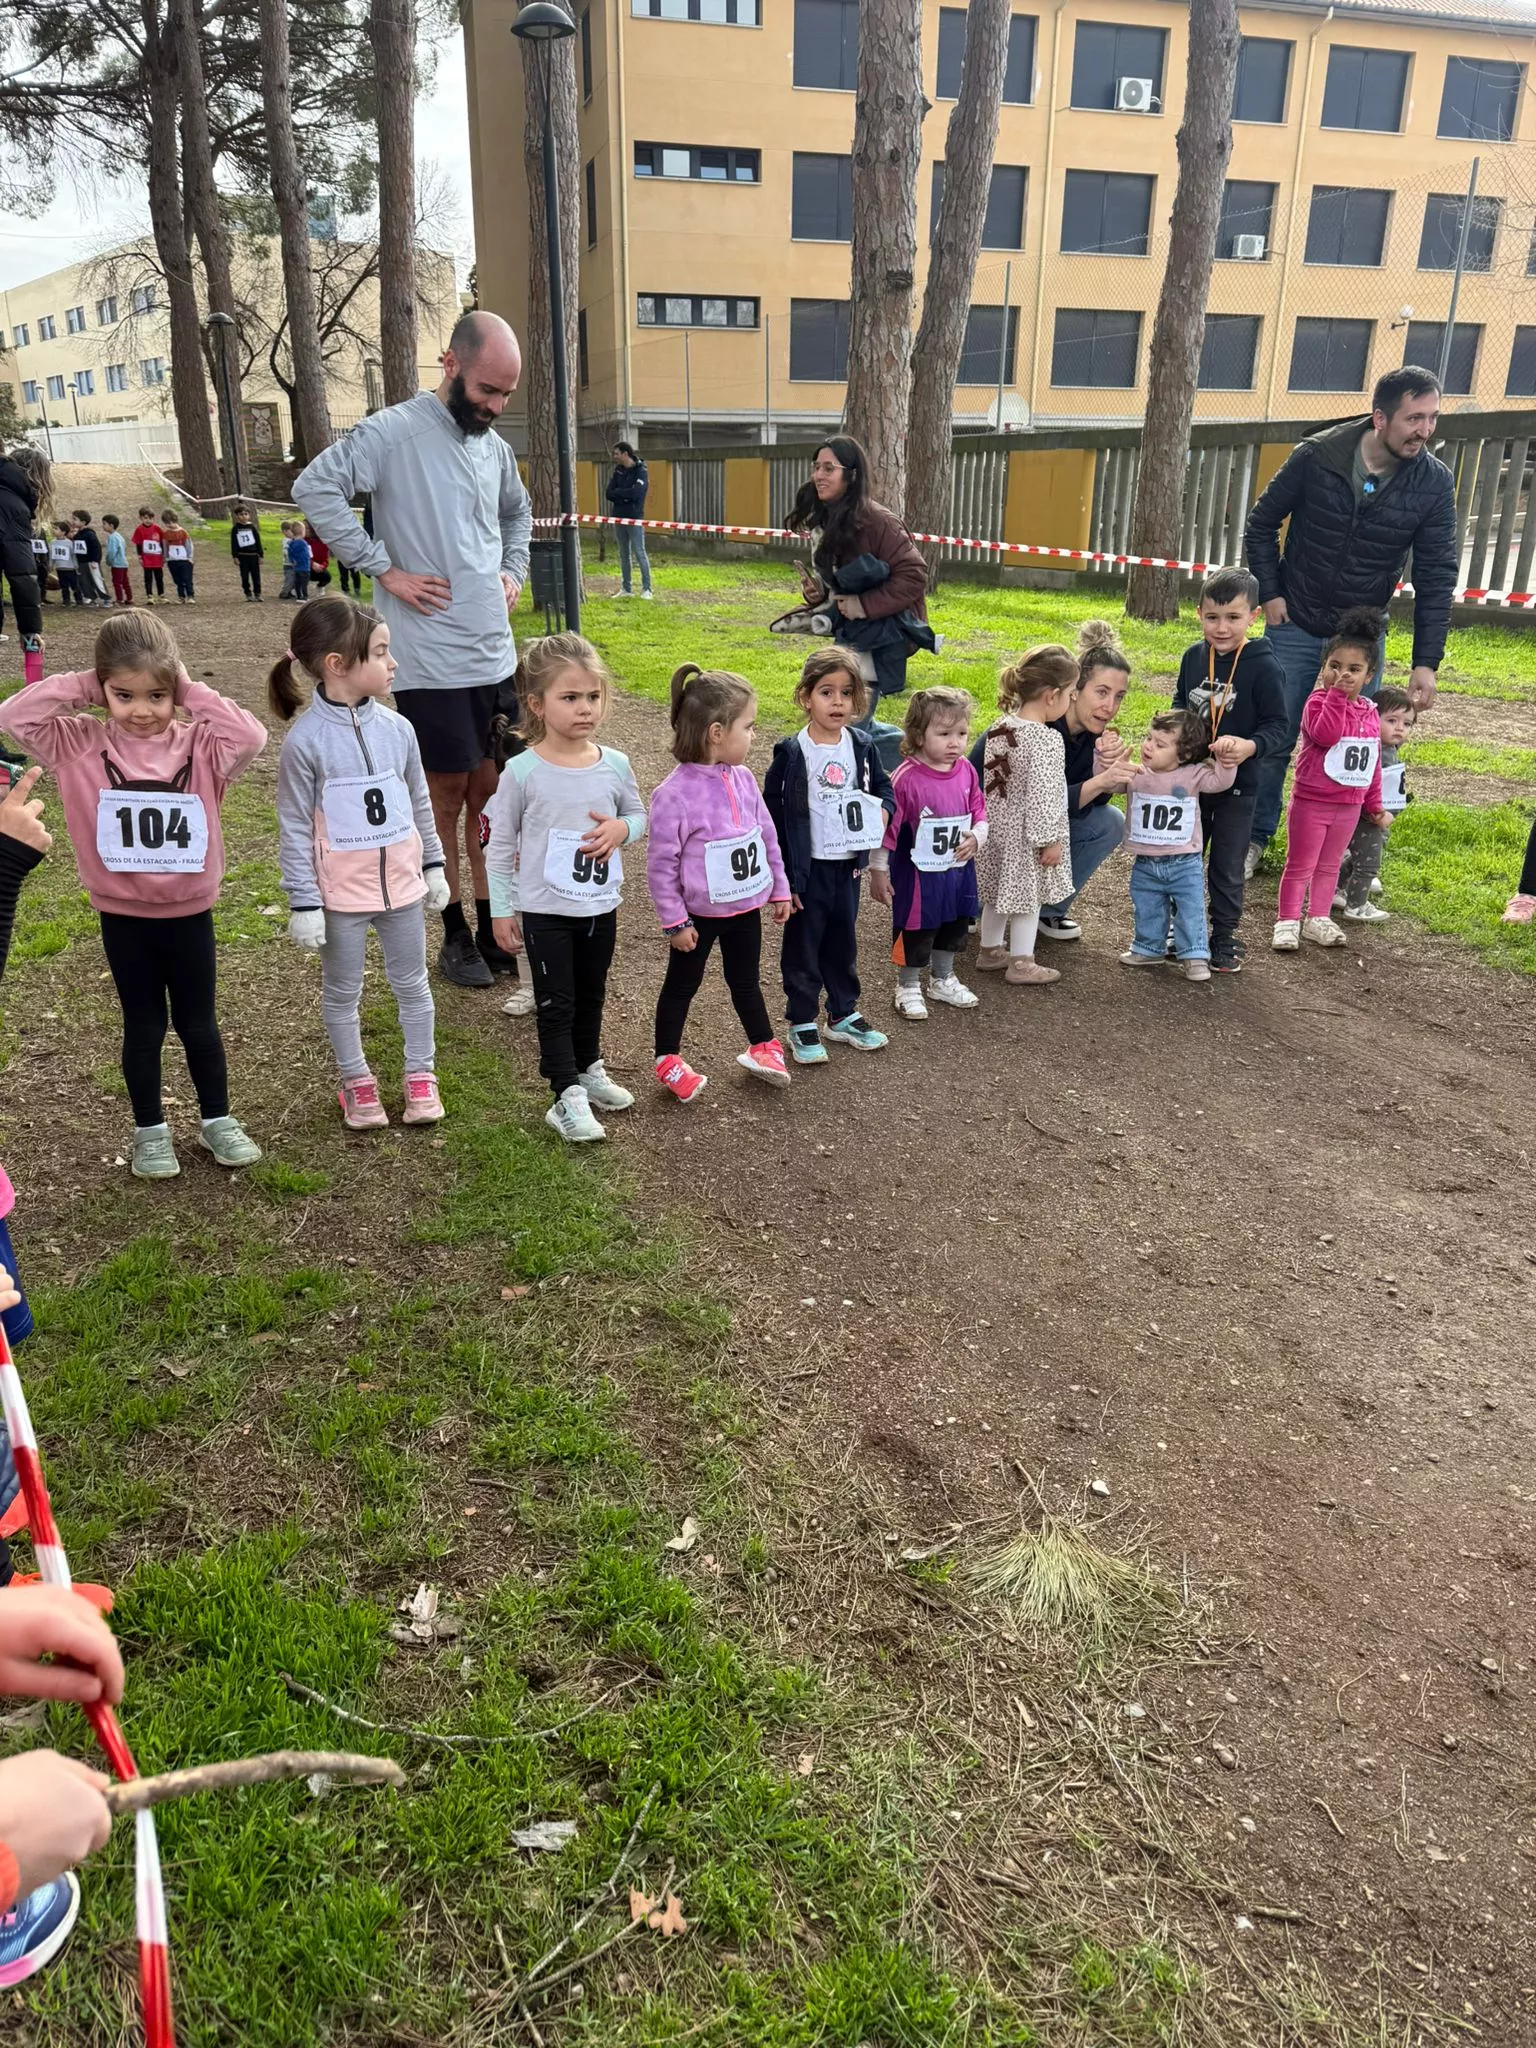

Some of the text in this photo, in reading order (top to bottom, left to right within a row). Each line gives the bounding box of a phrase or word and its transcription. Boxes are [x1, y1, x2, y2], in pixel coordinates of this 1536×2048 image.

[1344, 745, 1370, 771] 68
[364, 788, 387, 826] 8
[1142, 803, 1183, 831] 102
[116, 807, 191, 849] 104
[932, 825, 961, 856] 54
[142, 857, 178, 865] ESTACADA
[572, 848, 609, 885] 99
[731, 842, 761, 881] 92
